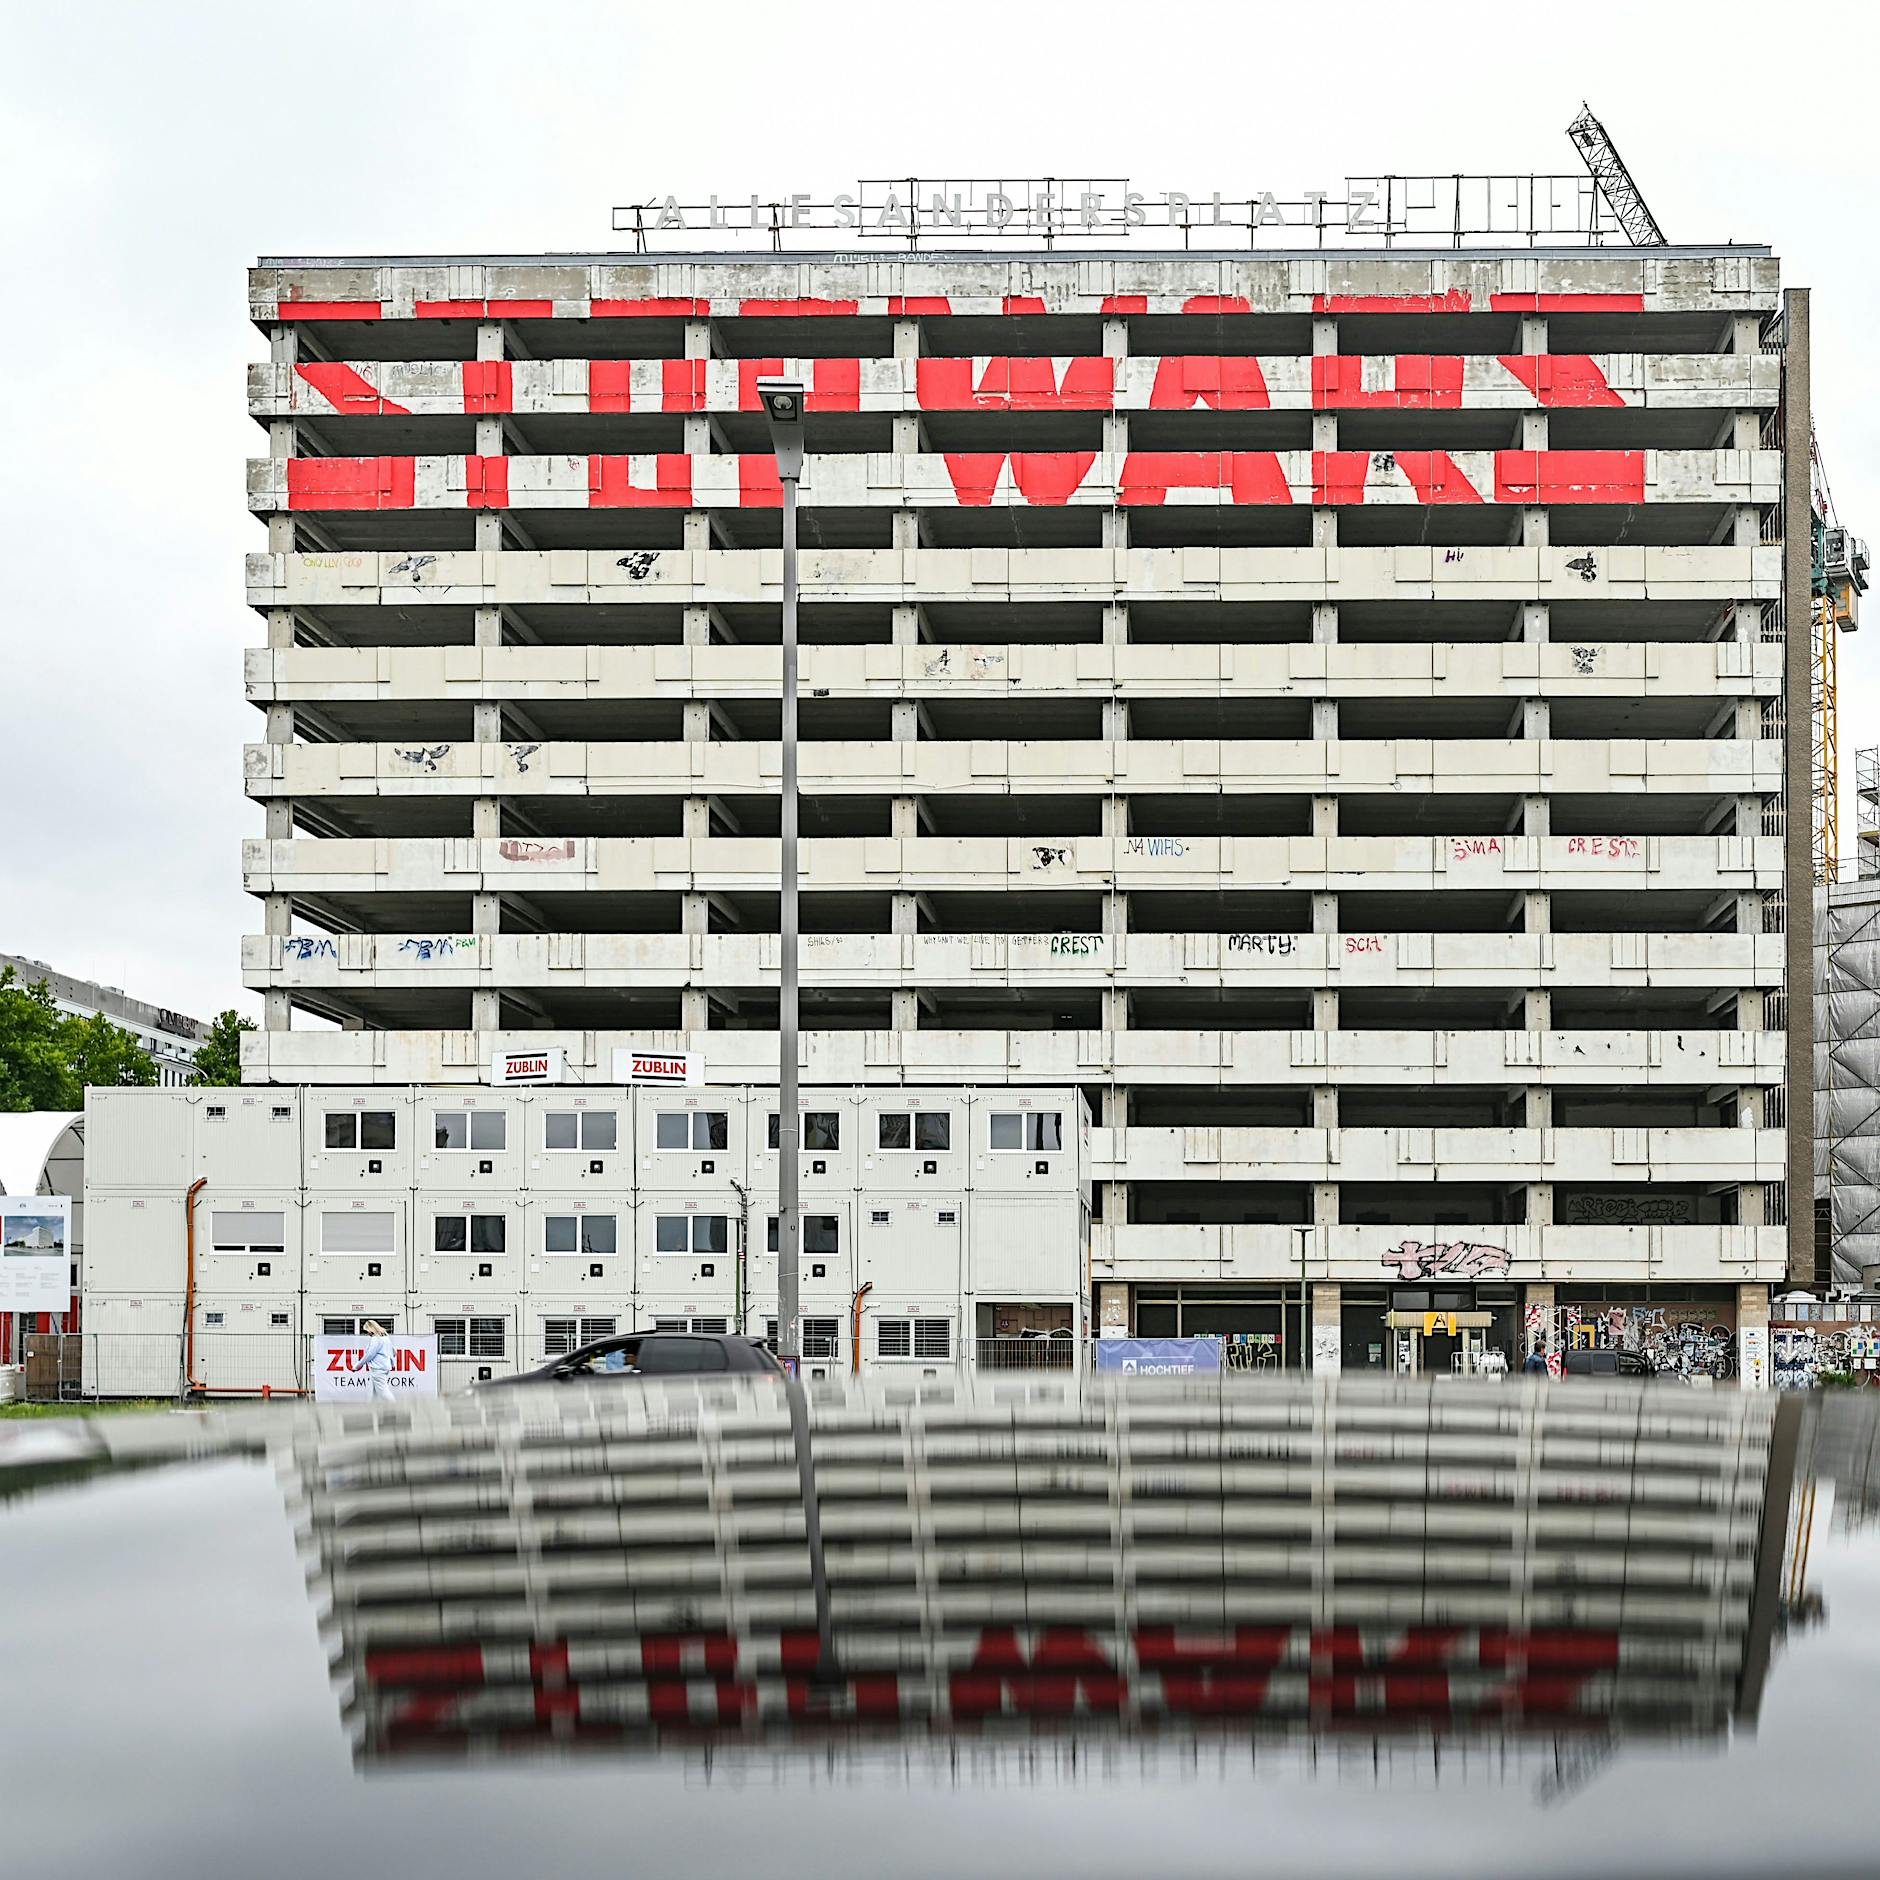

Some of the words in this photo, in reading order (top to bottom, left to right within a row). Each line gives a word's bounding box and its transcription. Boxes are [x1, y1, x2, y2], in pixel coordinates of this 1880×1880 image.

[505, 1059, 548, 1075] ZÜBLIN
[631, 1059, 687, 1075] ZÜBLIN
[326, 1348, 426, 1372] ZÜIN
[1140, 1364, 1195, 1376] HOCHTIEF
